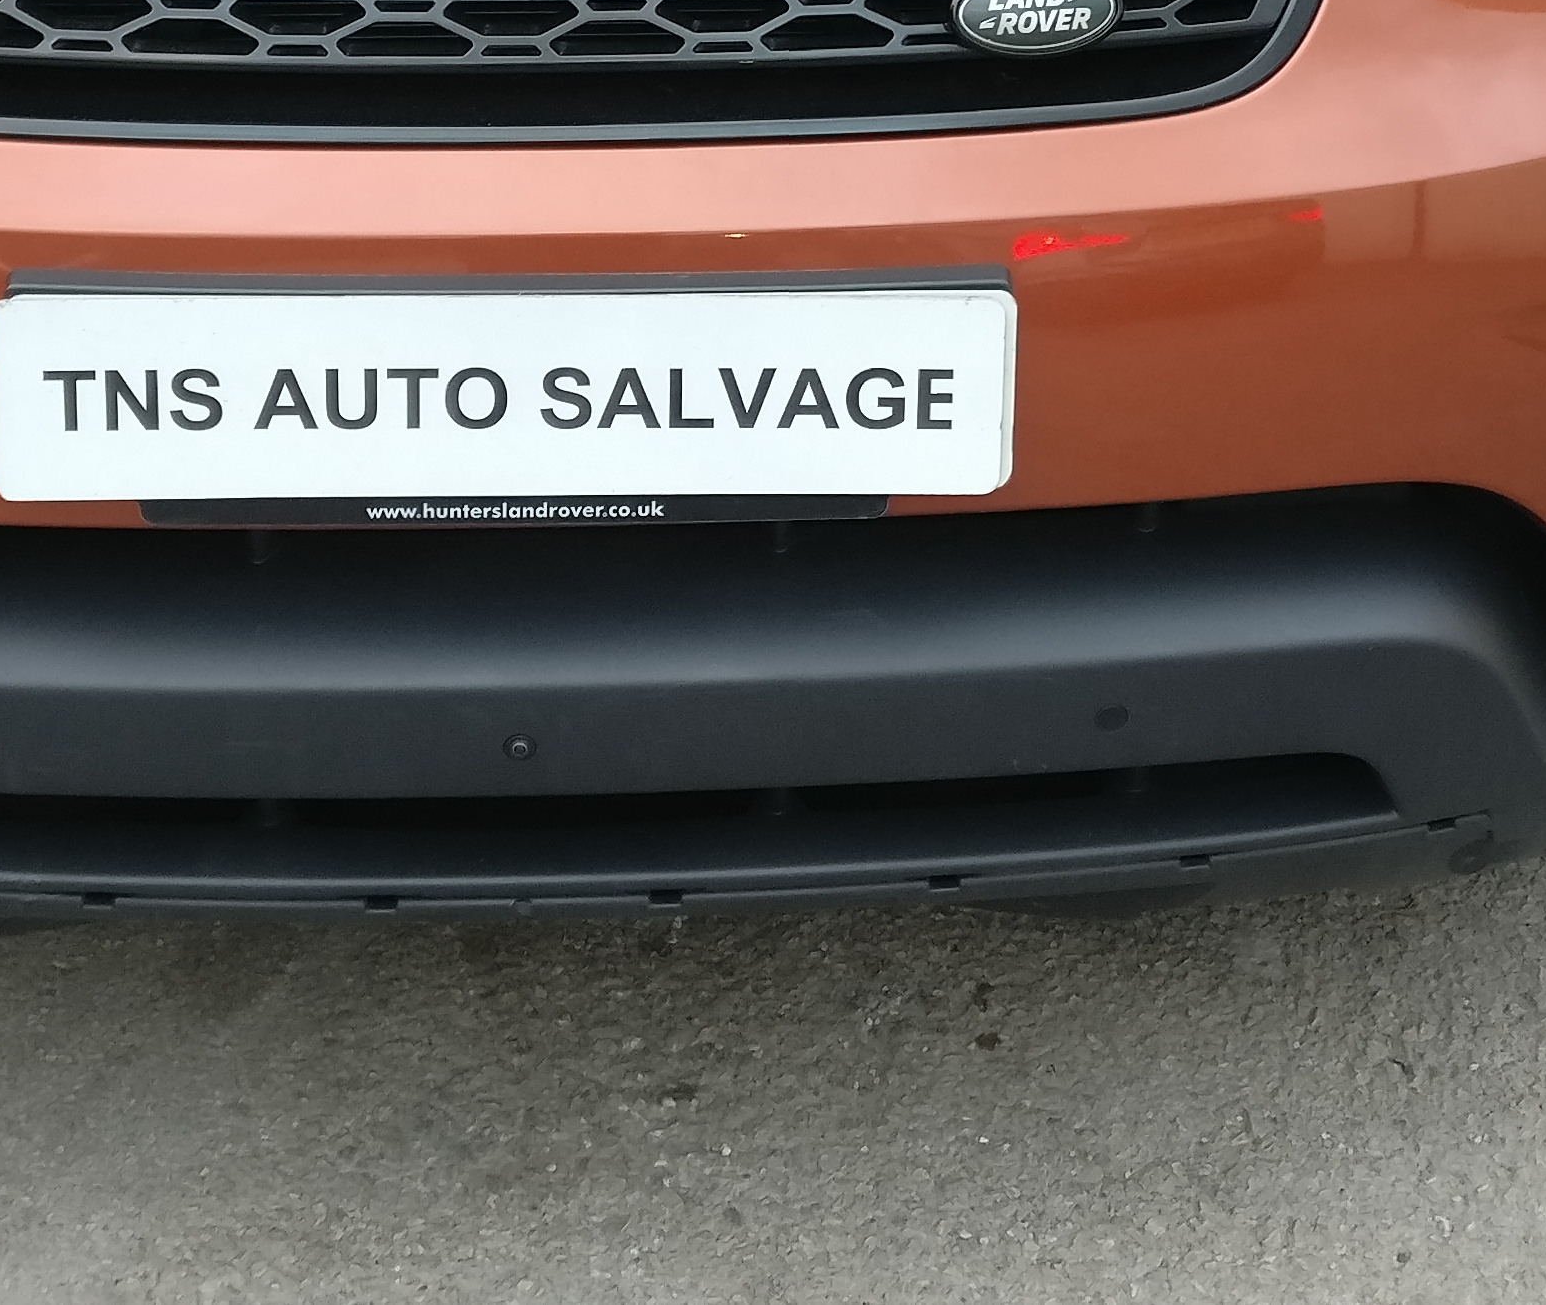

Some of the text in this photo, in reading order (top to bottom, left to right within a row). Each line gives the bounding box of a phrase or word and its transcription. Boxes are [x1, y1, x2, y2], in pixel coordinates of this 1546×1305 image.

[996, 8, 1092, 36] ROVER
[42, 367, 955, 432] TNS AUTO SALVAGE
[365, 500, 665, 520] www.hunterslandrover.co.uk
